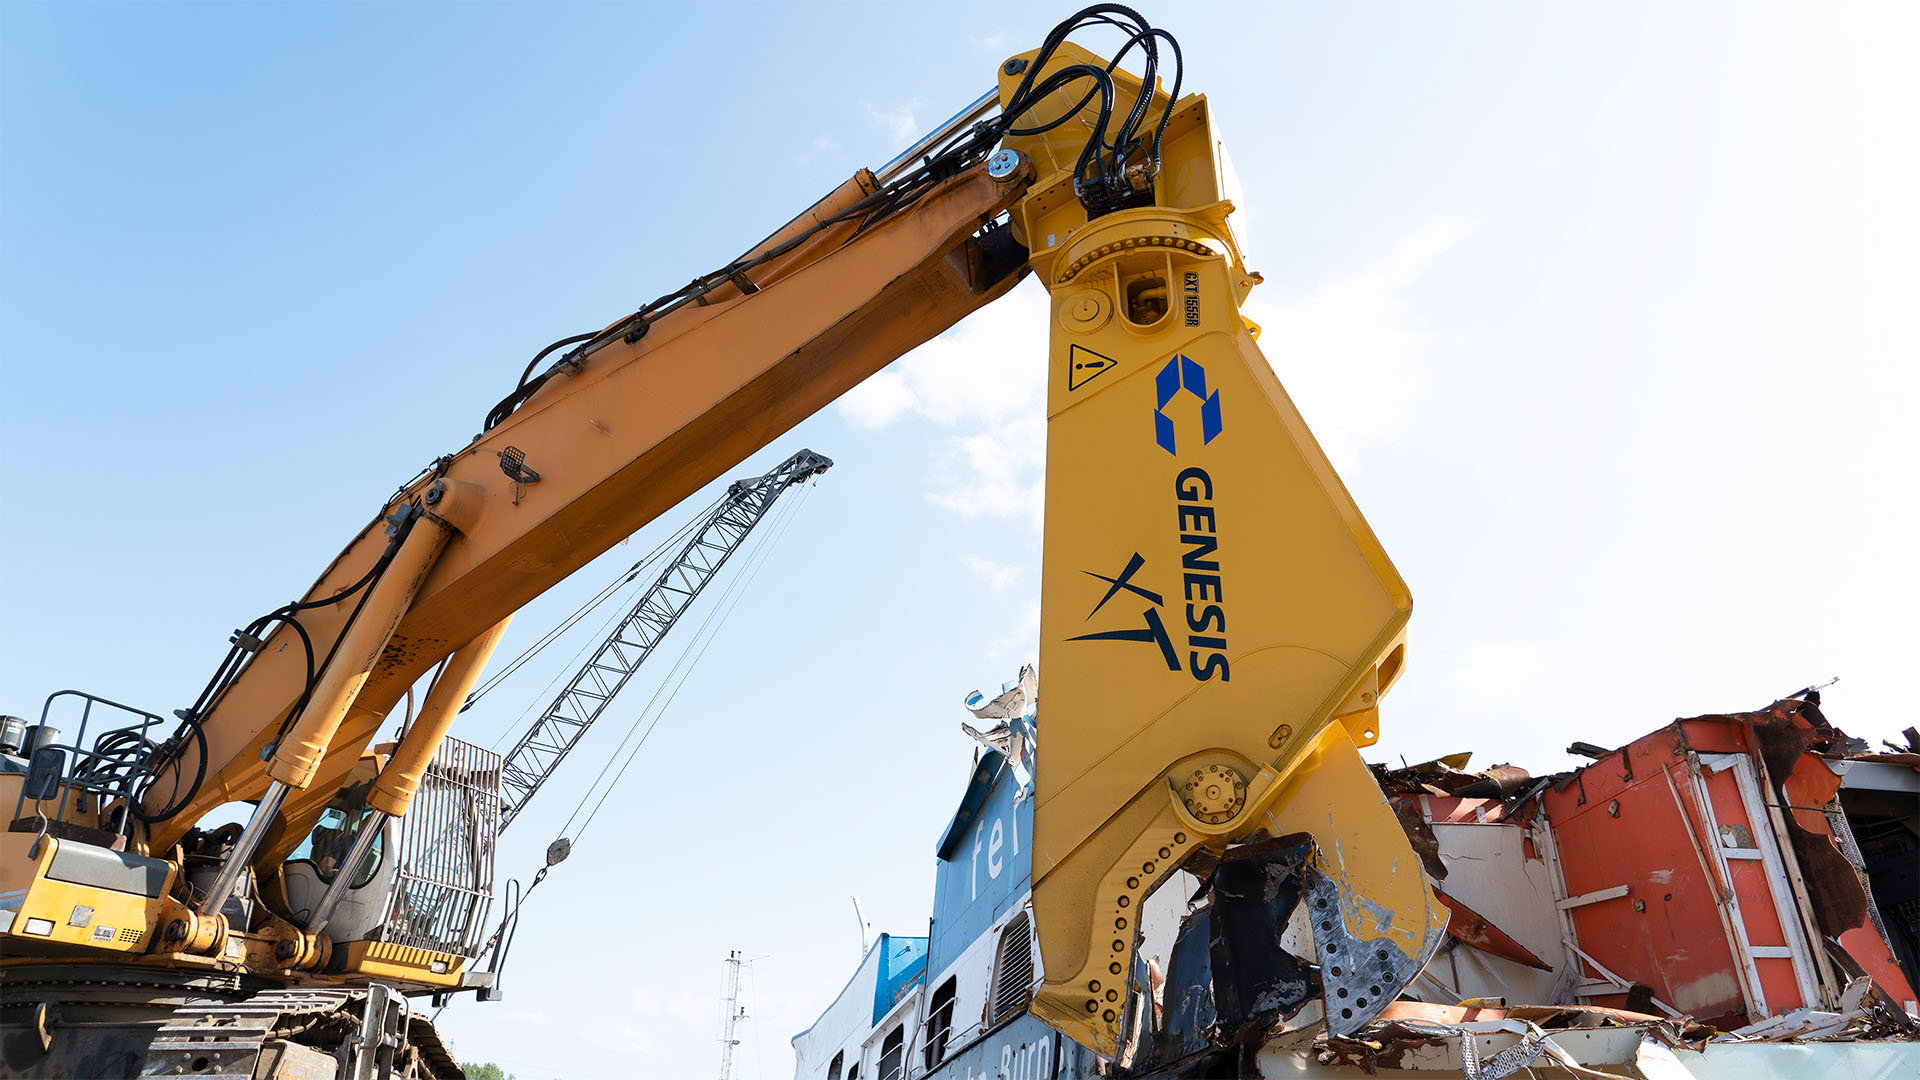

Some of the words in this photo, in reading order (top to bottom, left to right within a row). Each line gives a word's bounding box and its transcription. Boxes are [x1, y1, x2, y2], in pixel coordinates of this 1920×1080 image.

[1185, 272, 1199, 292] GXT
[1185, 295, 1199, 326] 1555R
[1175, 467, 1230, 682] GENESIS
